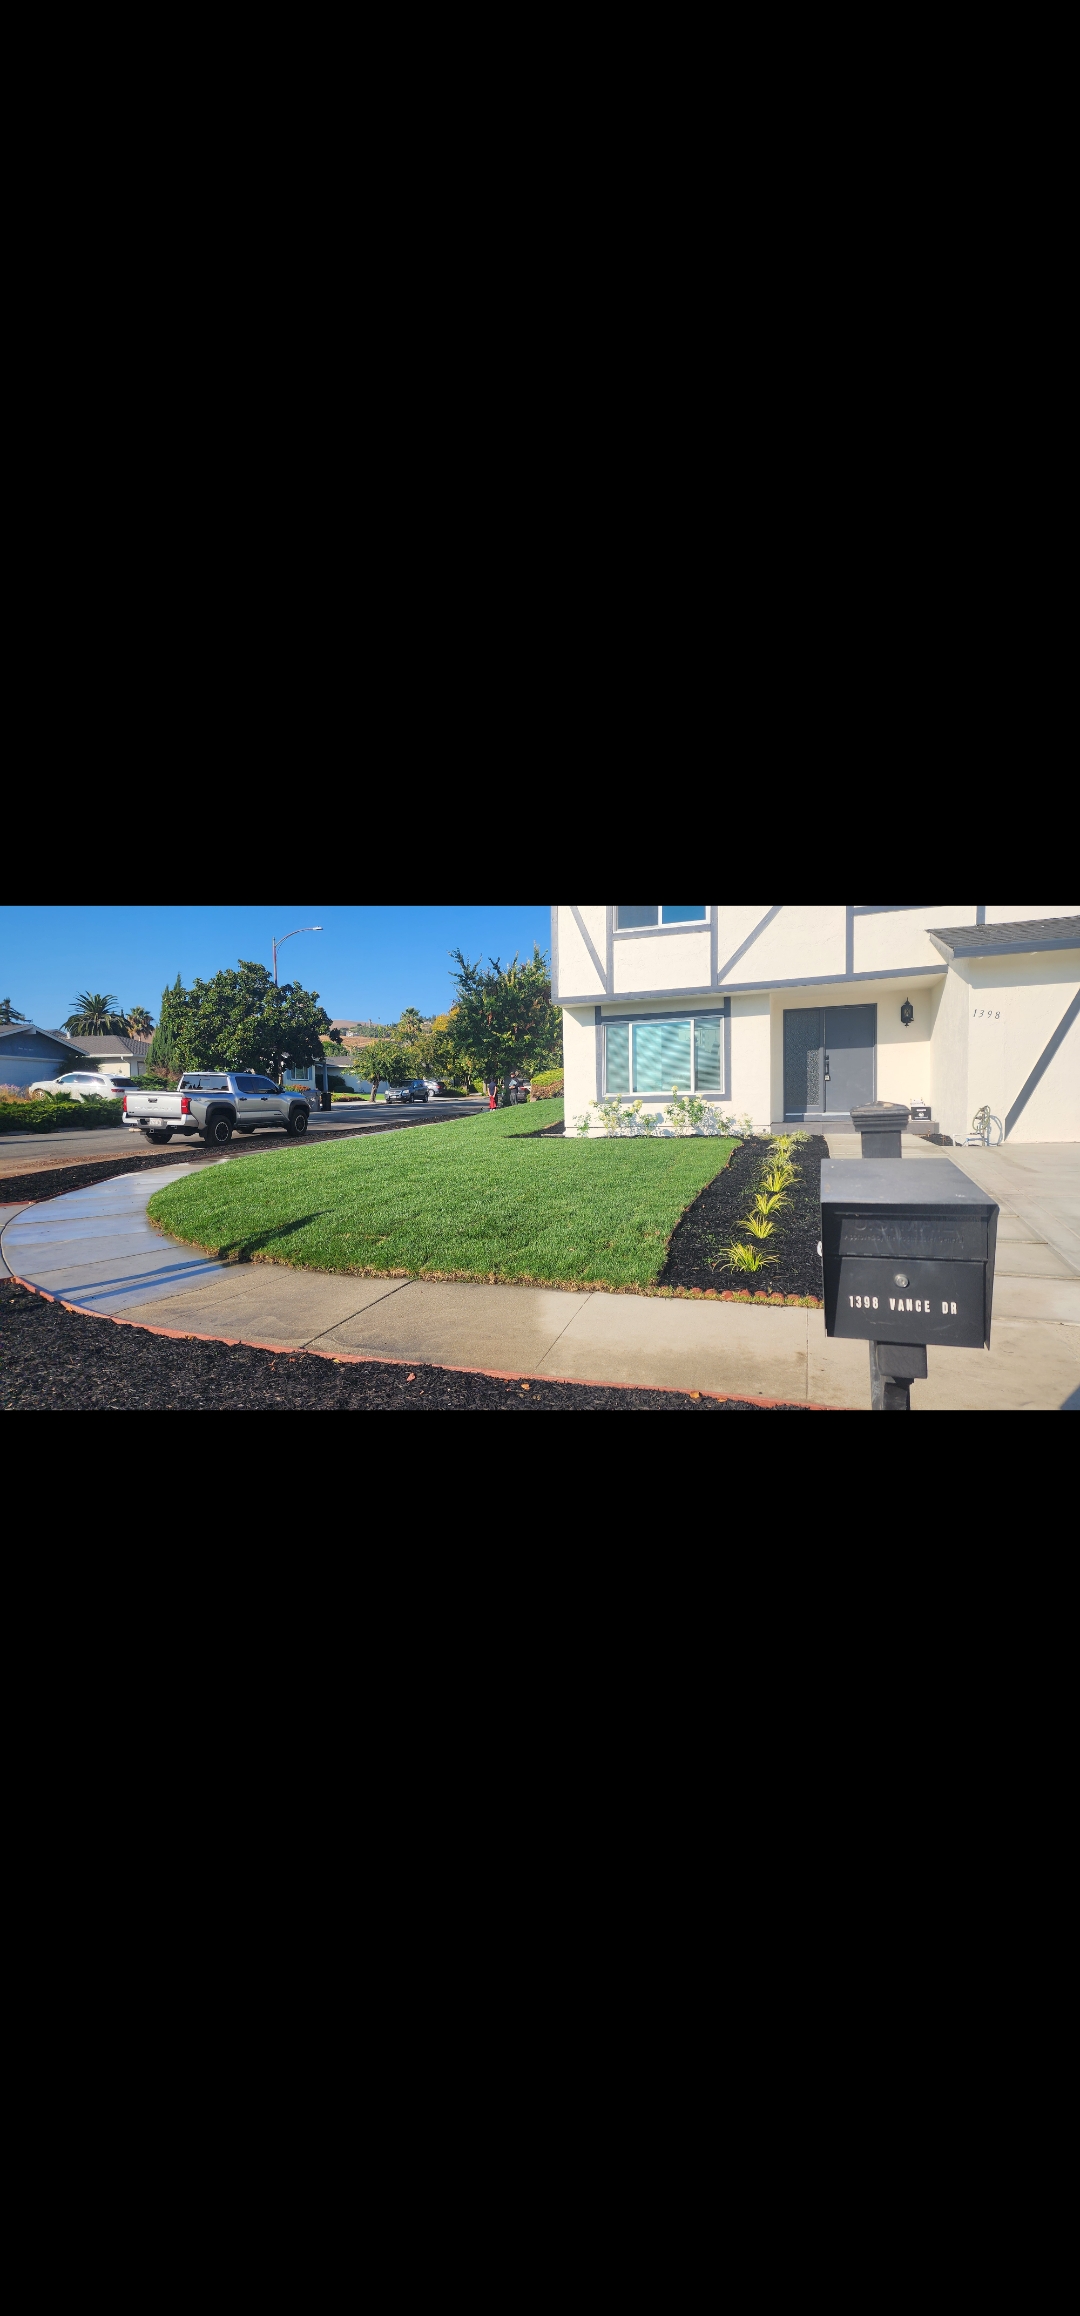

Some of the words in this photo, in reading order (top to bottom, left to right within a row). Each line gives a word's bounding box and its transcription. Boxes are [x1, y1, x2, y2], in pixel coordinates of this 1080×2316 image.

[973, 1009, 1001, 1020] 1398
[849, 1295, 879, 1310] 1398
[889, 1298, 931, 1313] VANCE
[941, 1301, 958, 1315] DR
